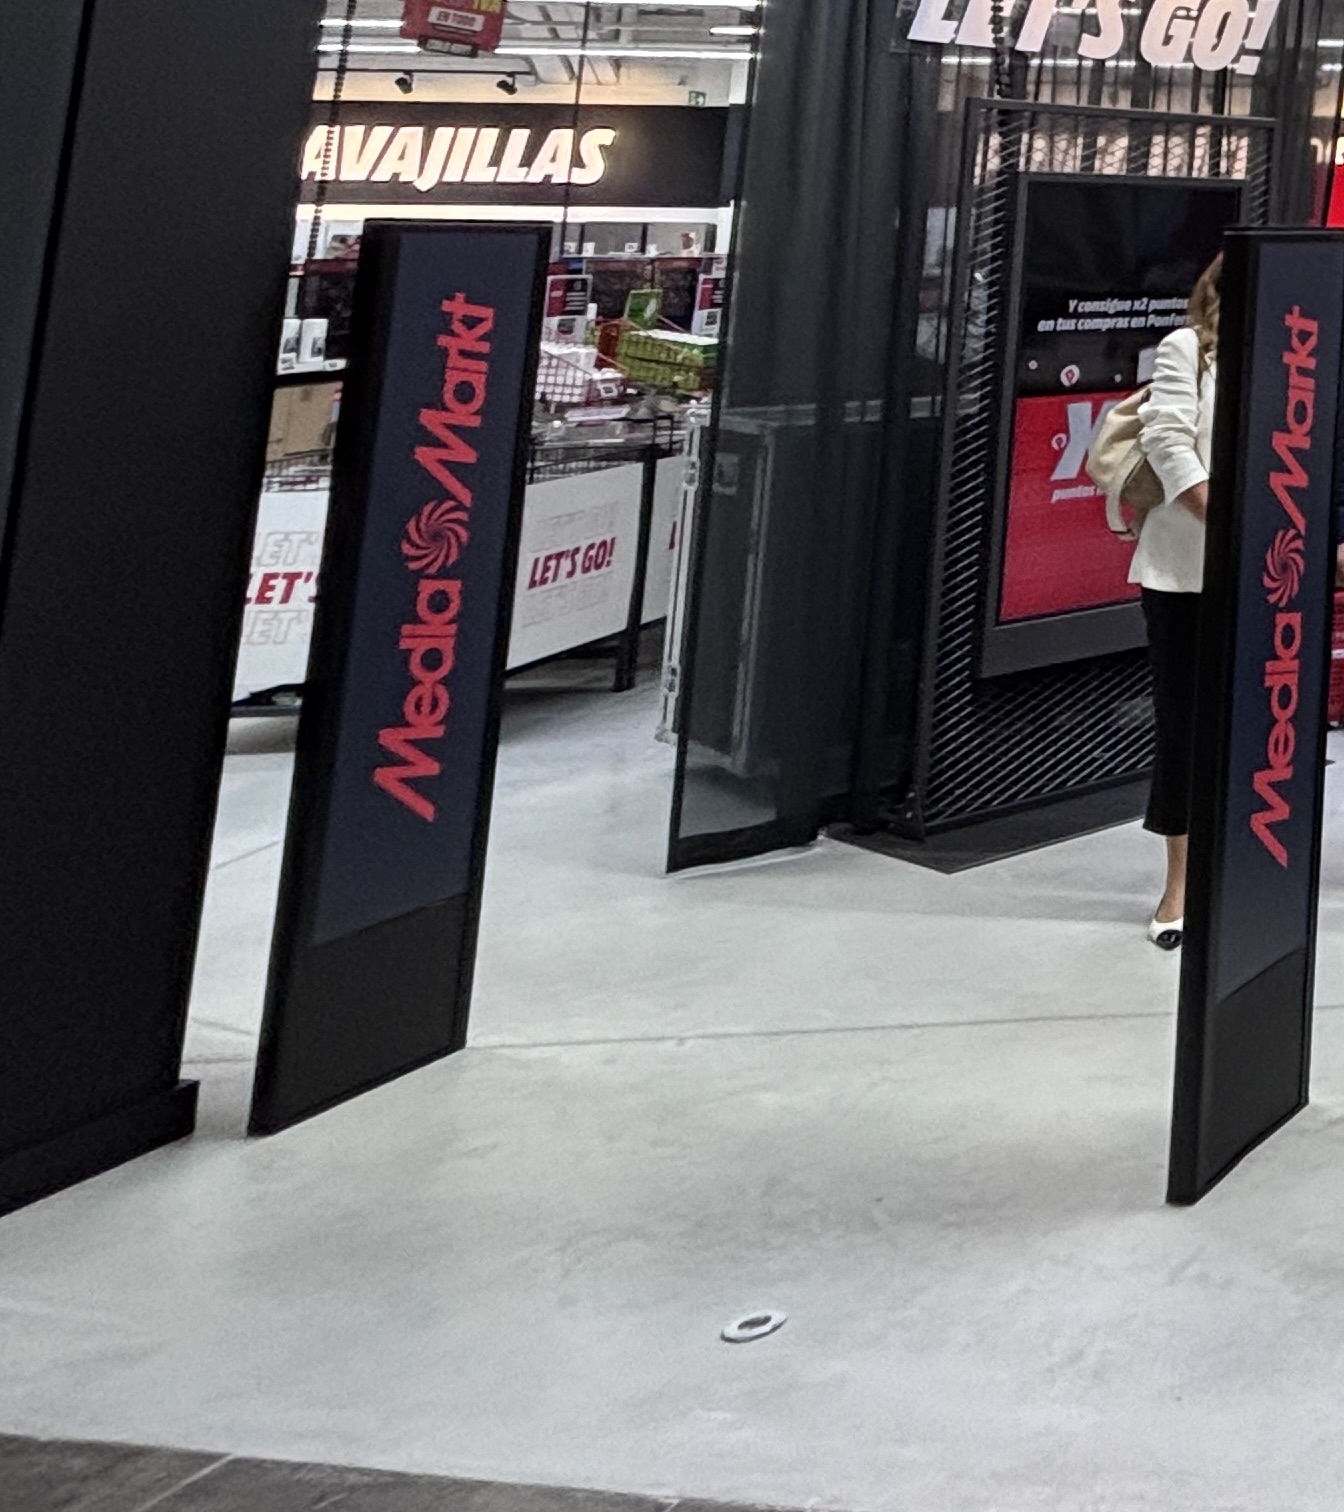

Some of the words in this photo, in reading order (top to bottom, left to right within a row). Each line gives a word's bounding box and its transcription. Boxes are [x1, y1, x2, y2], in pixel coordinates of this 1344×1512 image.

[413, 291, 496, 508] Markt
[1267, 305, 1321, 540] Markt
[245, 571, 317, 605] ET'
[528, 545, 582, 590] LET'S
[581, 536, 617, 574] GO!
[373, 578, 463, 822] Media
[1249, 612, 1304, 869] Media
